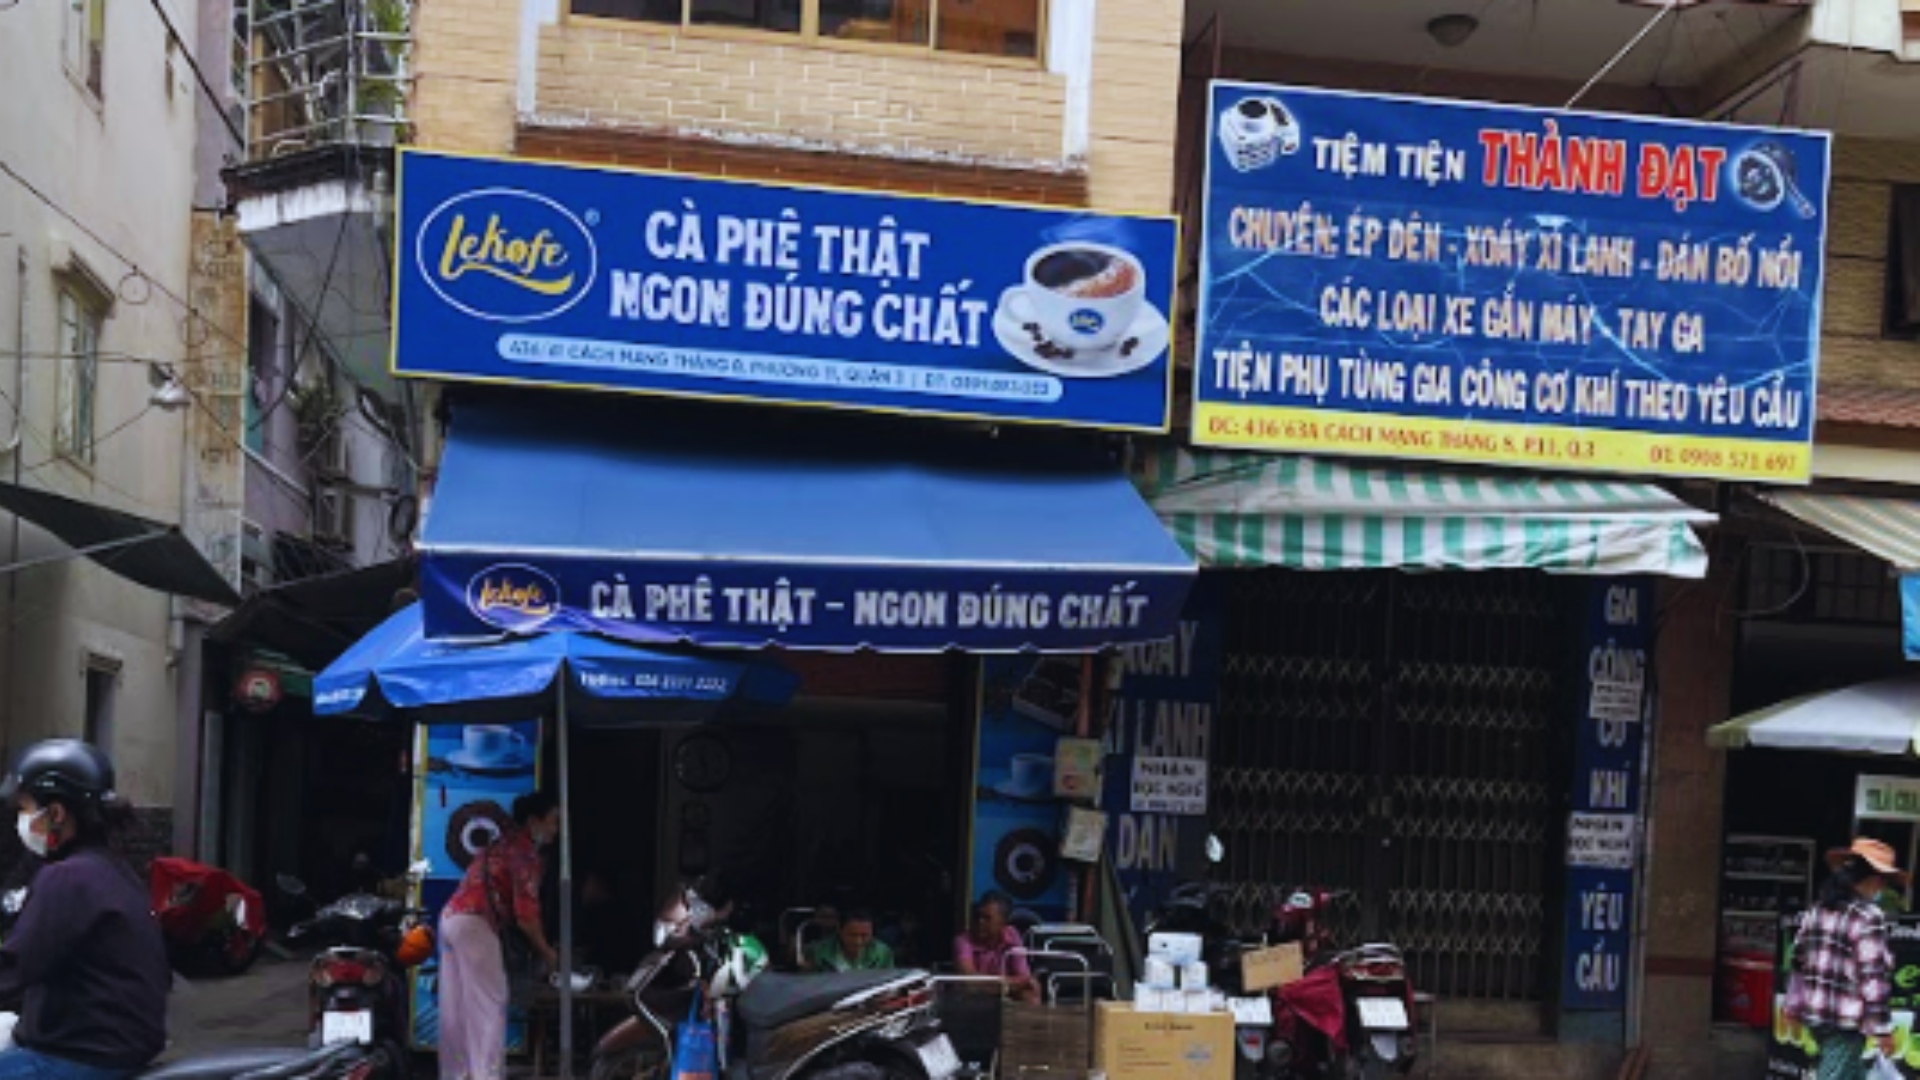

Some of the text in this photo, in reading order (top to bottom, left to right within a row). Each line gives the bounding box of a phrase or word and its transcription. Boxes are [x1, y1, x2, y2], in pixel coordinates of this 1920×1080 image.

[1312, 131, 1387, 180] TIỆM
[1396, 139, 1465, 187] TIỆN
[1638, 142, 1726, 212] ĐẠT
[645, 198, 930, 287] CÀ PHÊ THẬT
[1345, 205, 1382, 258] ÉP
[1464, 217, 1529, 269] XOÁY
[1569, 234, 1634, 278] LANH
[609, 269, 988, 347] NGON ĐÚNG CHẤT
[1320, 276, 1371, 330] CÁC
[1377, 290, 1436, 342] LOẠI
[1443, 296, 1476, 336] XE
[1539, 295, 1593, 345] MÁY
[1617, 308, 1665, 351] TAY
[1672, 311, 1705, 353] GA
[1212, 340, 1272, 399] TIỆN
[1278, 352, 1328, 405] PHỤ
[1338, 348, 1406, 402] TÙNG
[1413, 362, 1452, 405] GIA
[1460, 357, 1527, 410] CÔNG
[1534, 368, 1569, 414] CƠ
[1574, 368, 1620, 417] KHÍ
[1624, 378, 1689, 421] THEO
[1697, 375, 1745, 425] YÊU
[590, 572, 636, 619] CÀ
[645, 573, 712, 622] PHÊ
[722, 576, 817, 633] THẬT
[854, 590, 947, 627] NGON
[957, 582, 1050, 629] ĐÚNG
[1058, 580, 1149, 630] CHẤT
